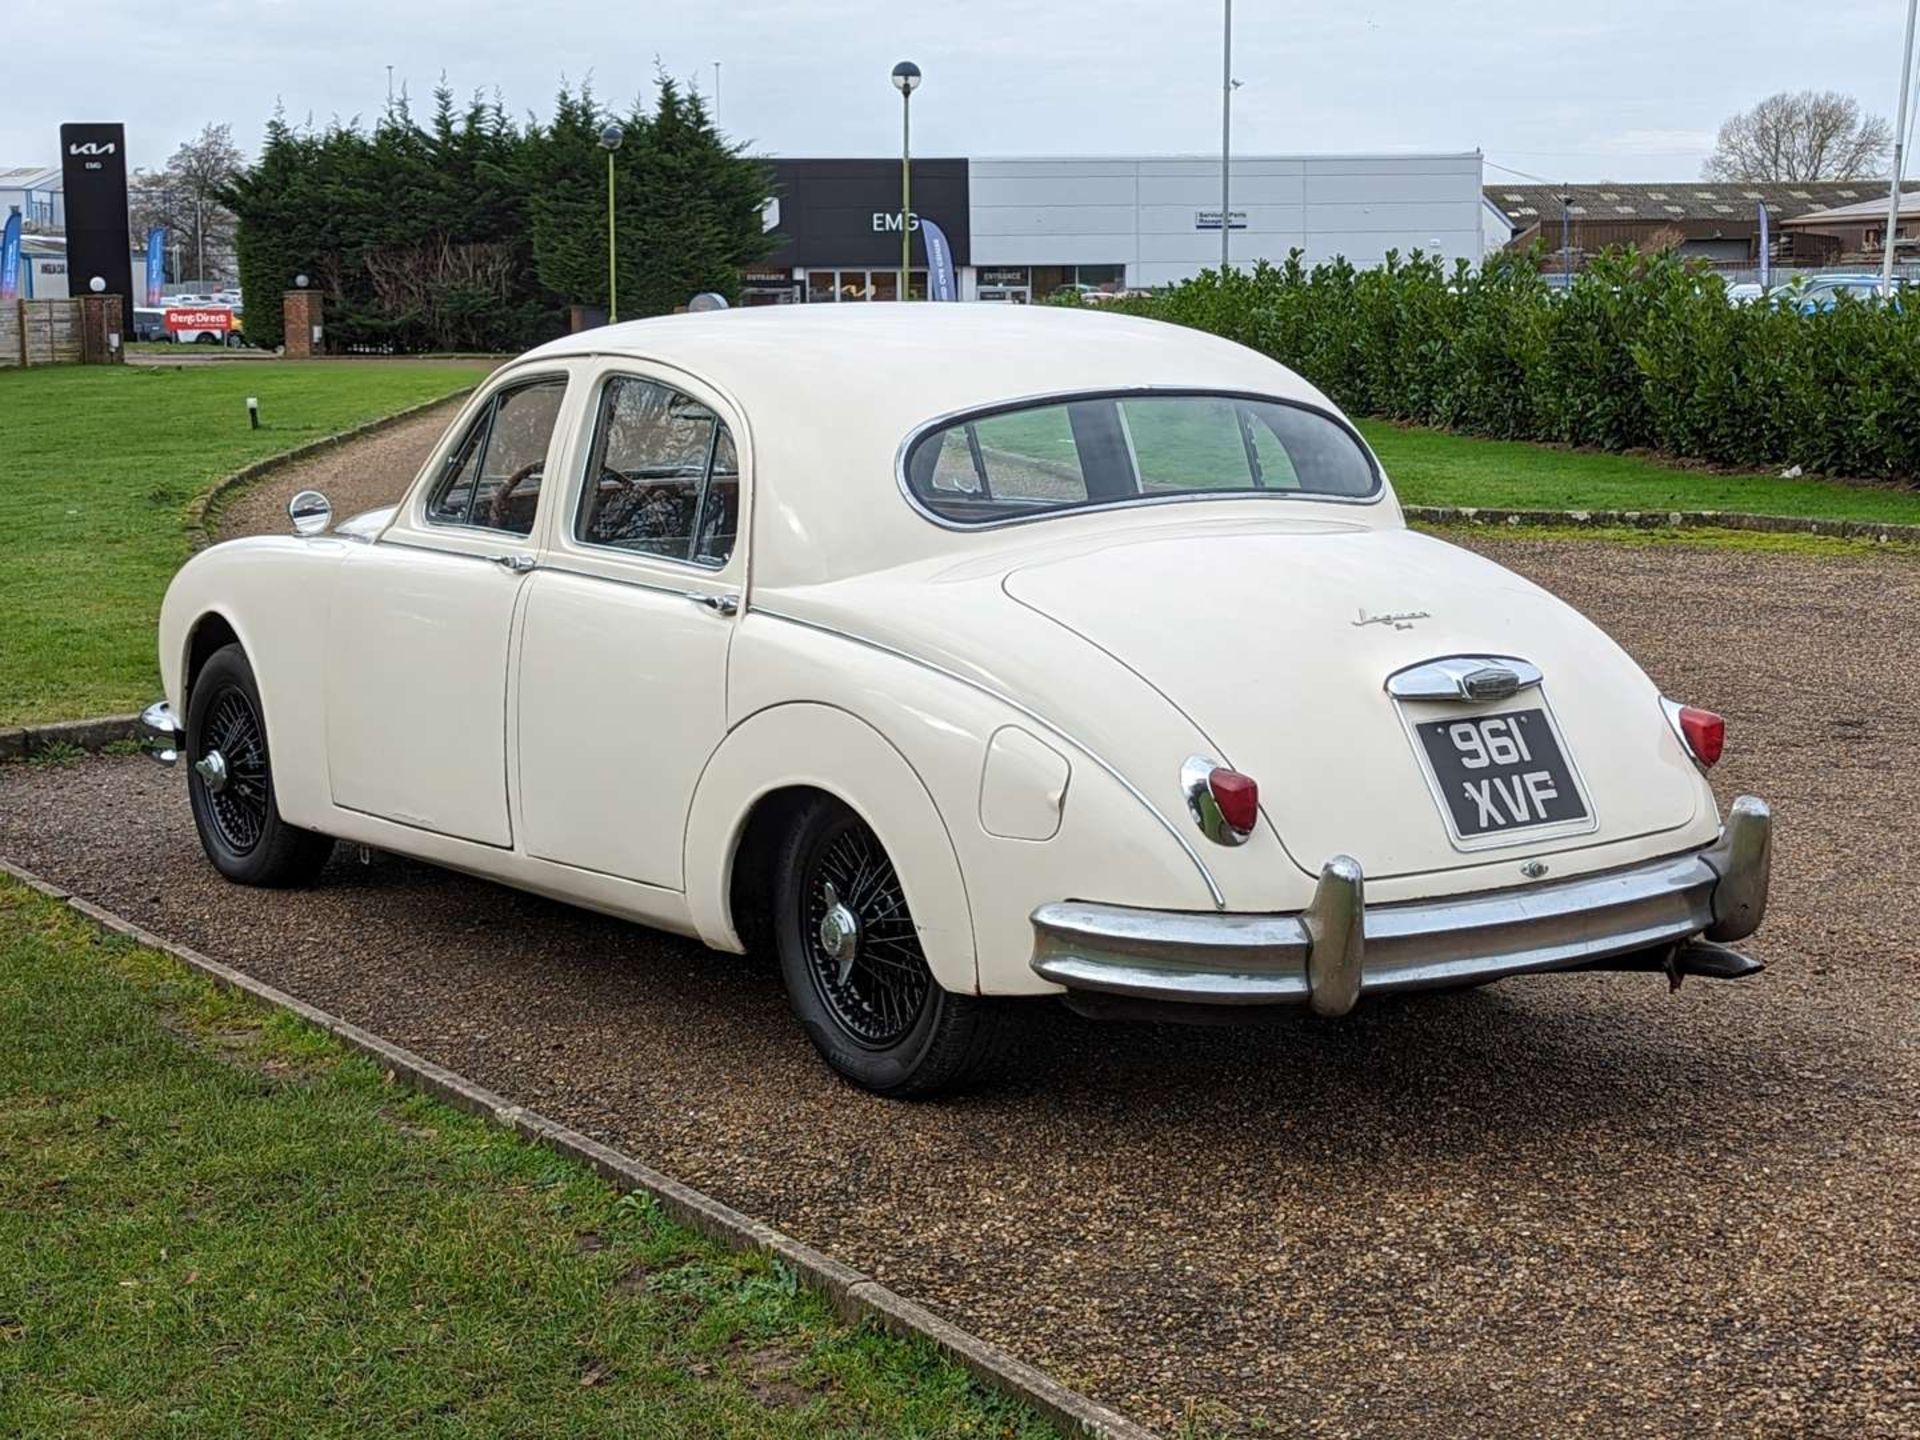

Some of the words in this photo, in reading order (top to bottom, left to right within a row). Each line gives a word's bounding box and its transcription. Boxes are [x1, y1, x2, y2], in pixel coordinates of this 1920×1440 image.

[69, 142, 115, 155] KIA
[872, 212, 920, 231] EMG
[1449, 717, 1532, 769] 961
[1462, 770, 1558, 829] XVF
